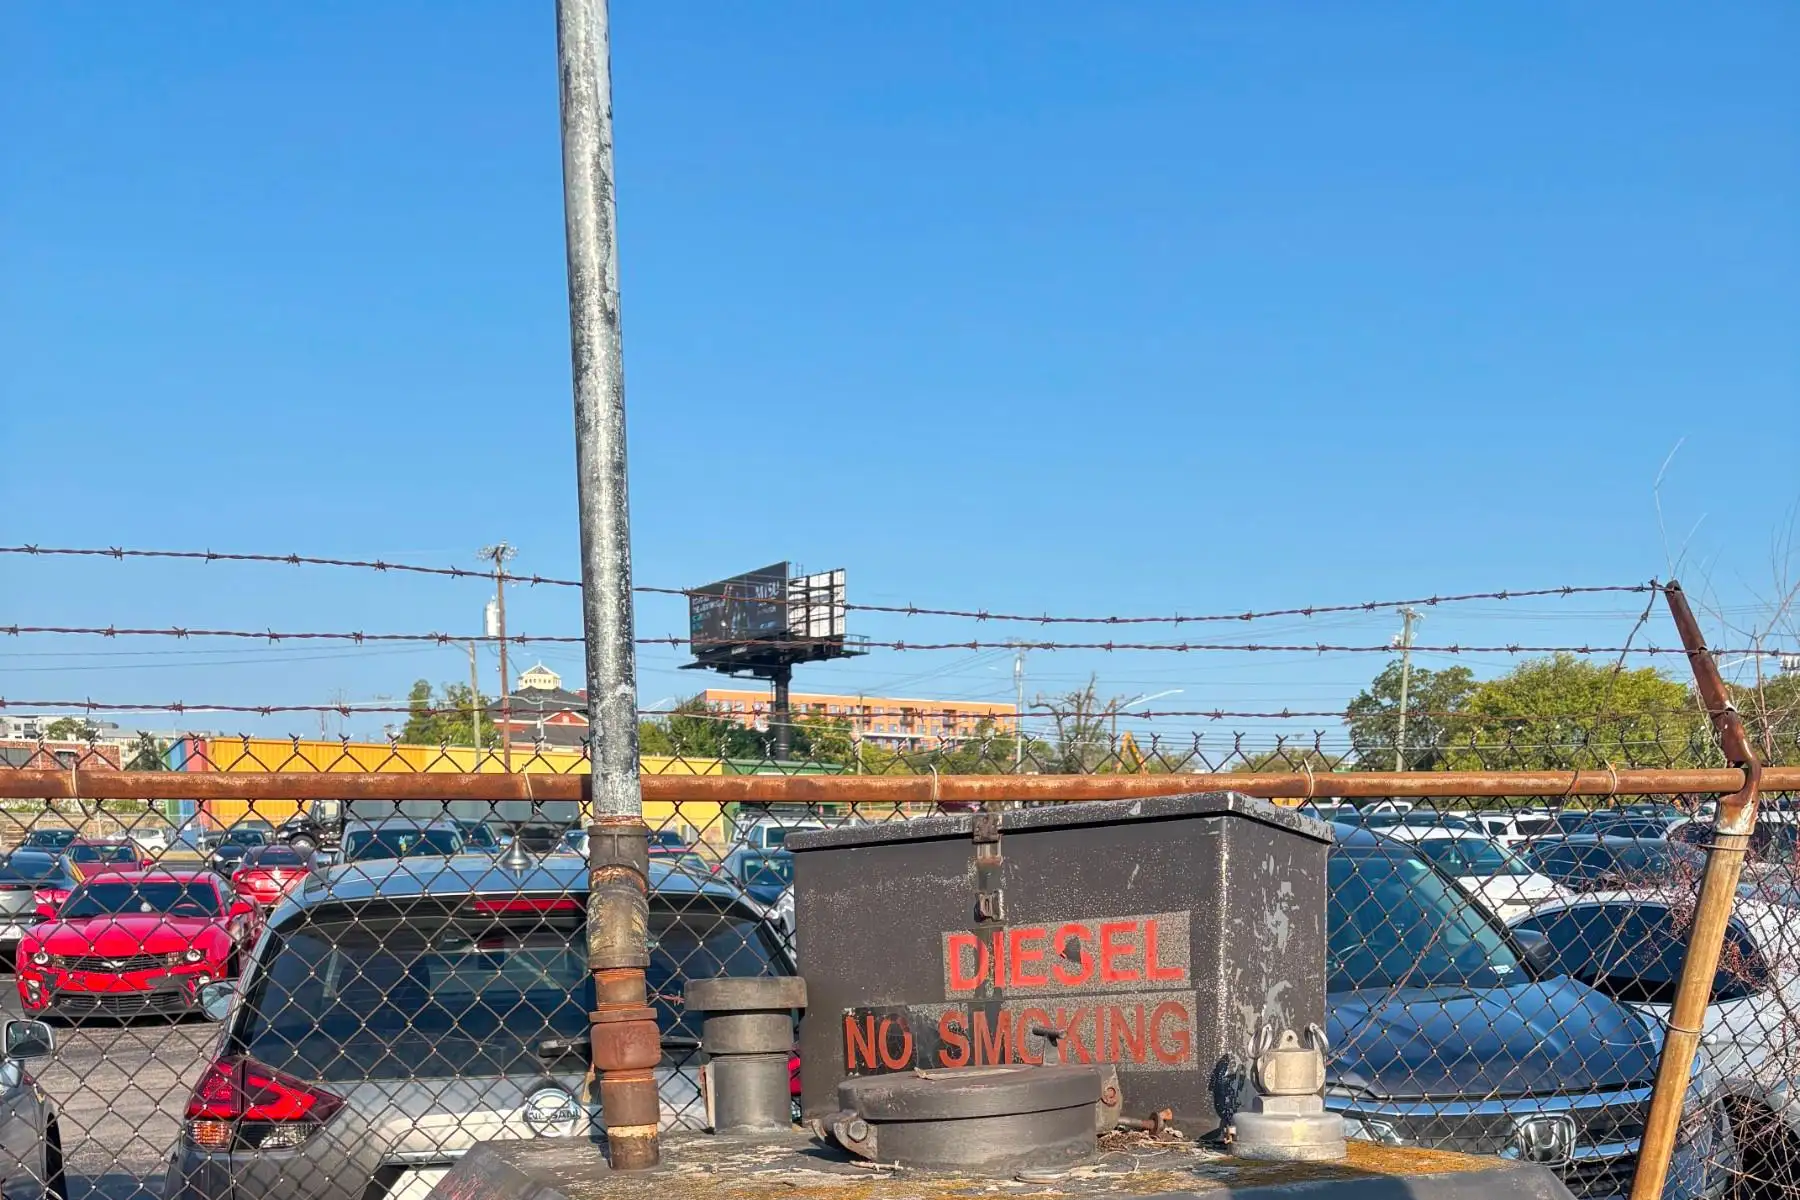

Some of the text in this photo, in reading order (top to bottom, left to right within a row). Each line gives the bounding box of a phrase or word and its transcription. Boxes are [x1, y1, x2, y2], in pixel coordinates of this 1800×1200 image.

[946, 919, 1185, 991] DIESEL
[845, 1001, 1191, 1069] NO SMOKING
